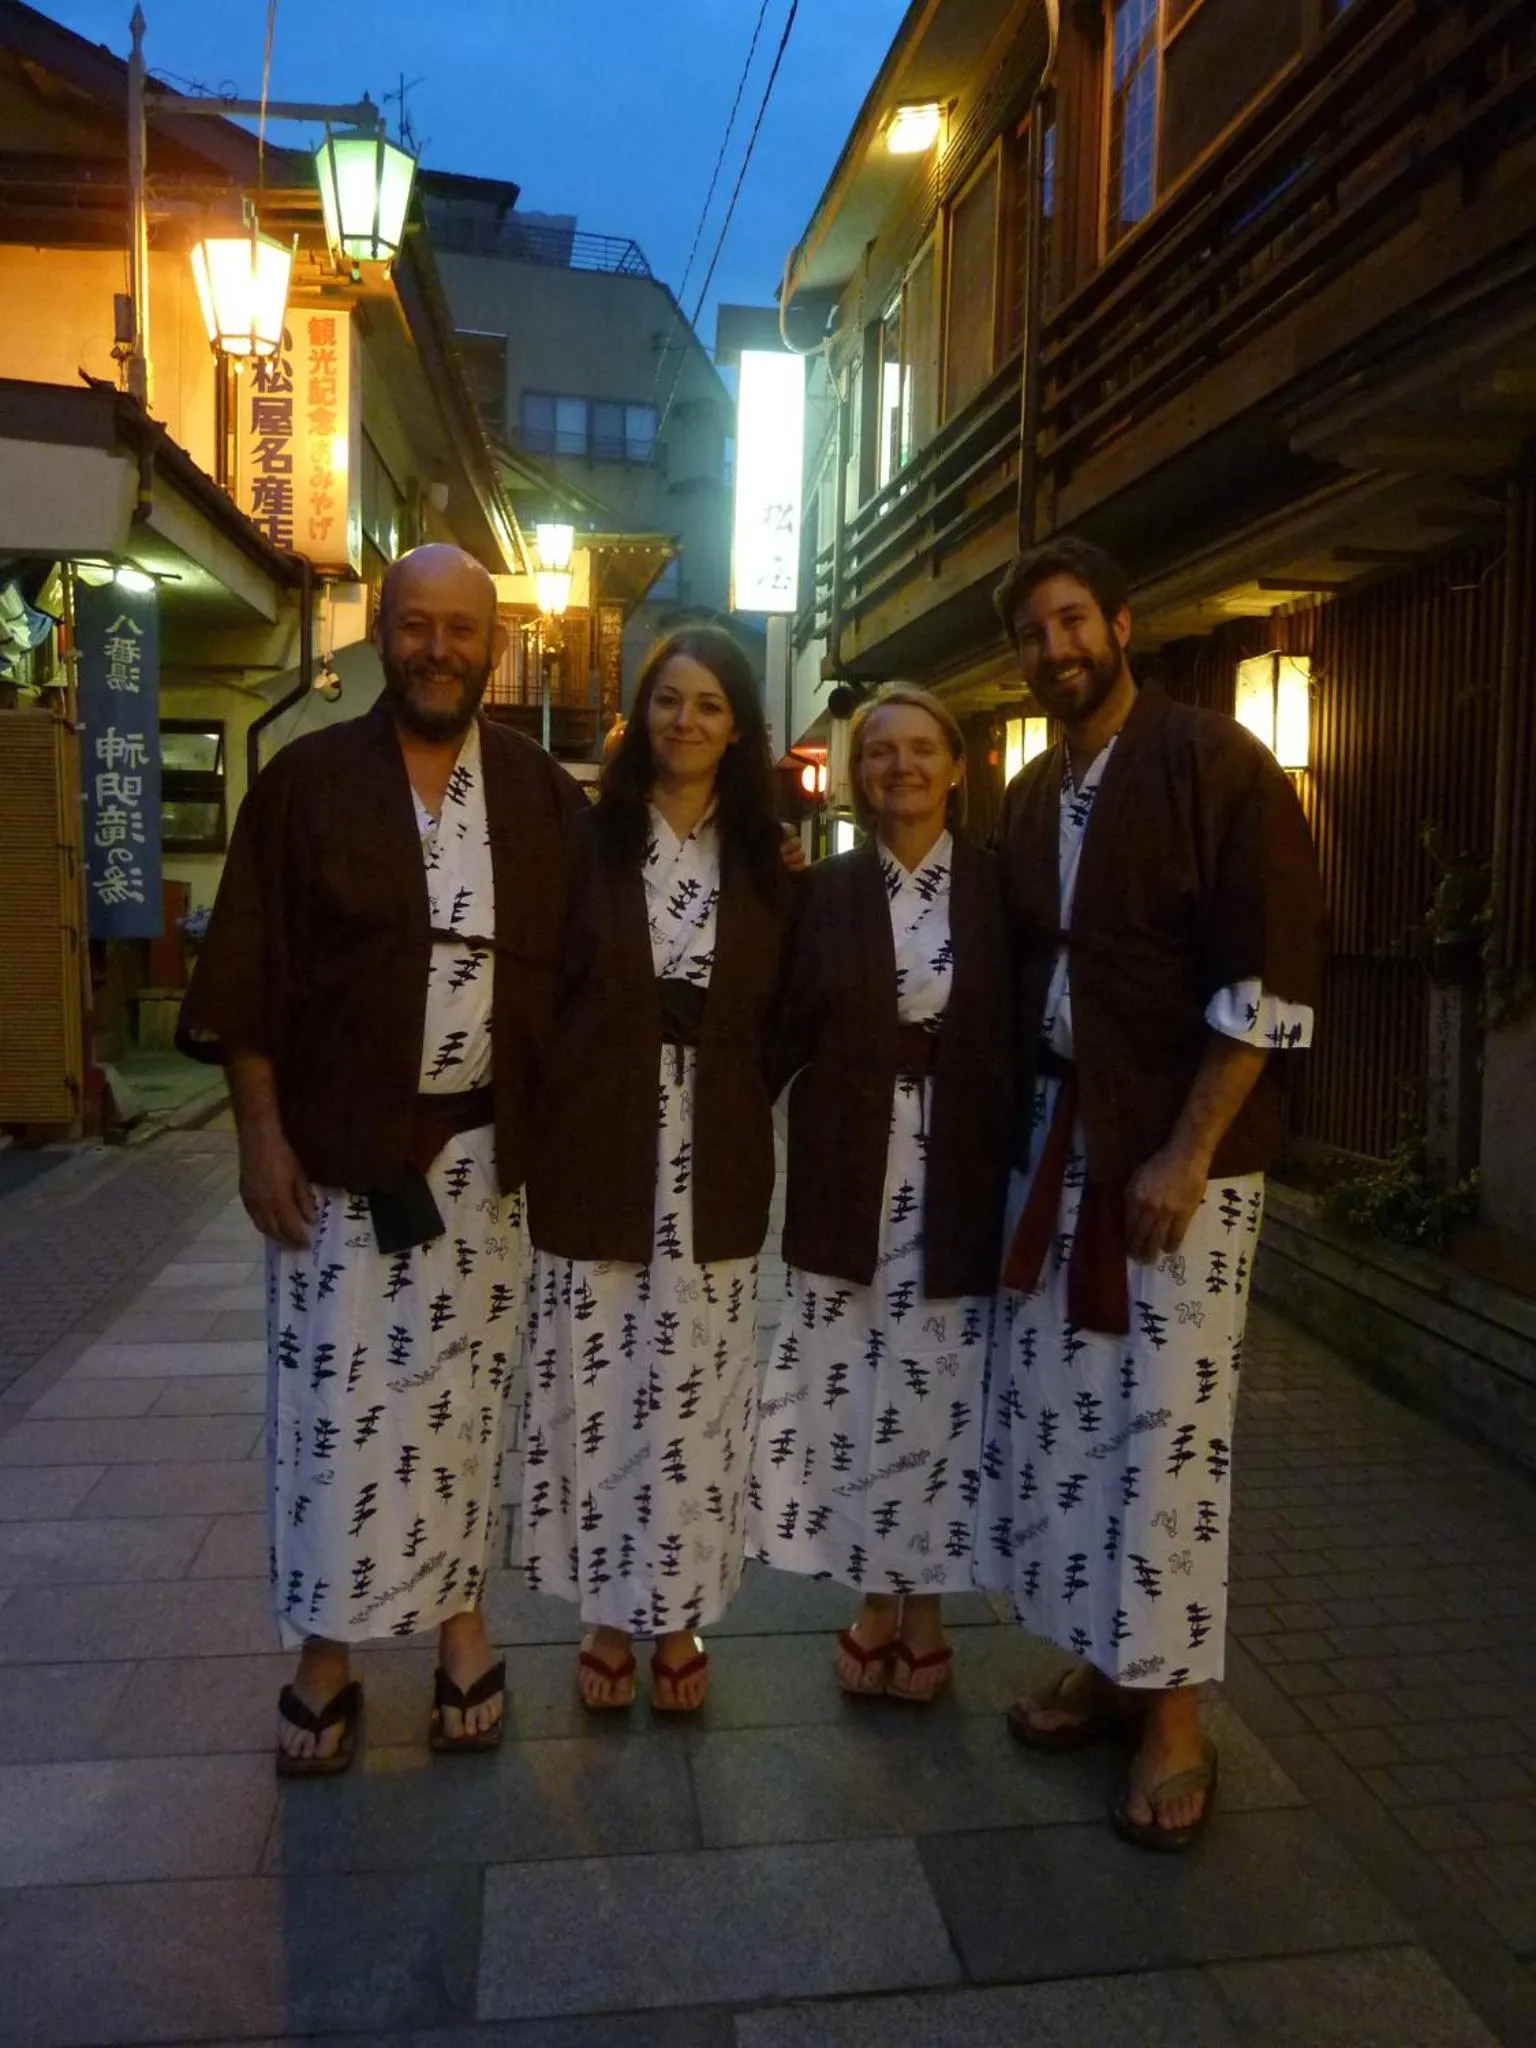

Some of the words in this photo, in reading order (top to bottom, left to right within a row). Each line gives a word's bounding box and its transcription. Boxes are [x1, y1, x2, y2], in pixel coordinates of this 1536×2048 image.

[307, 317, 337, 541] 観光記念おみやげ
